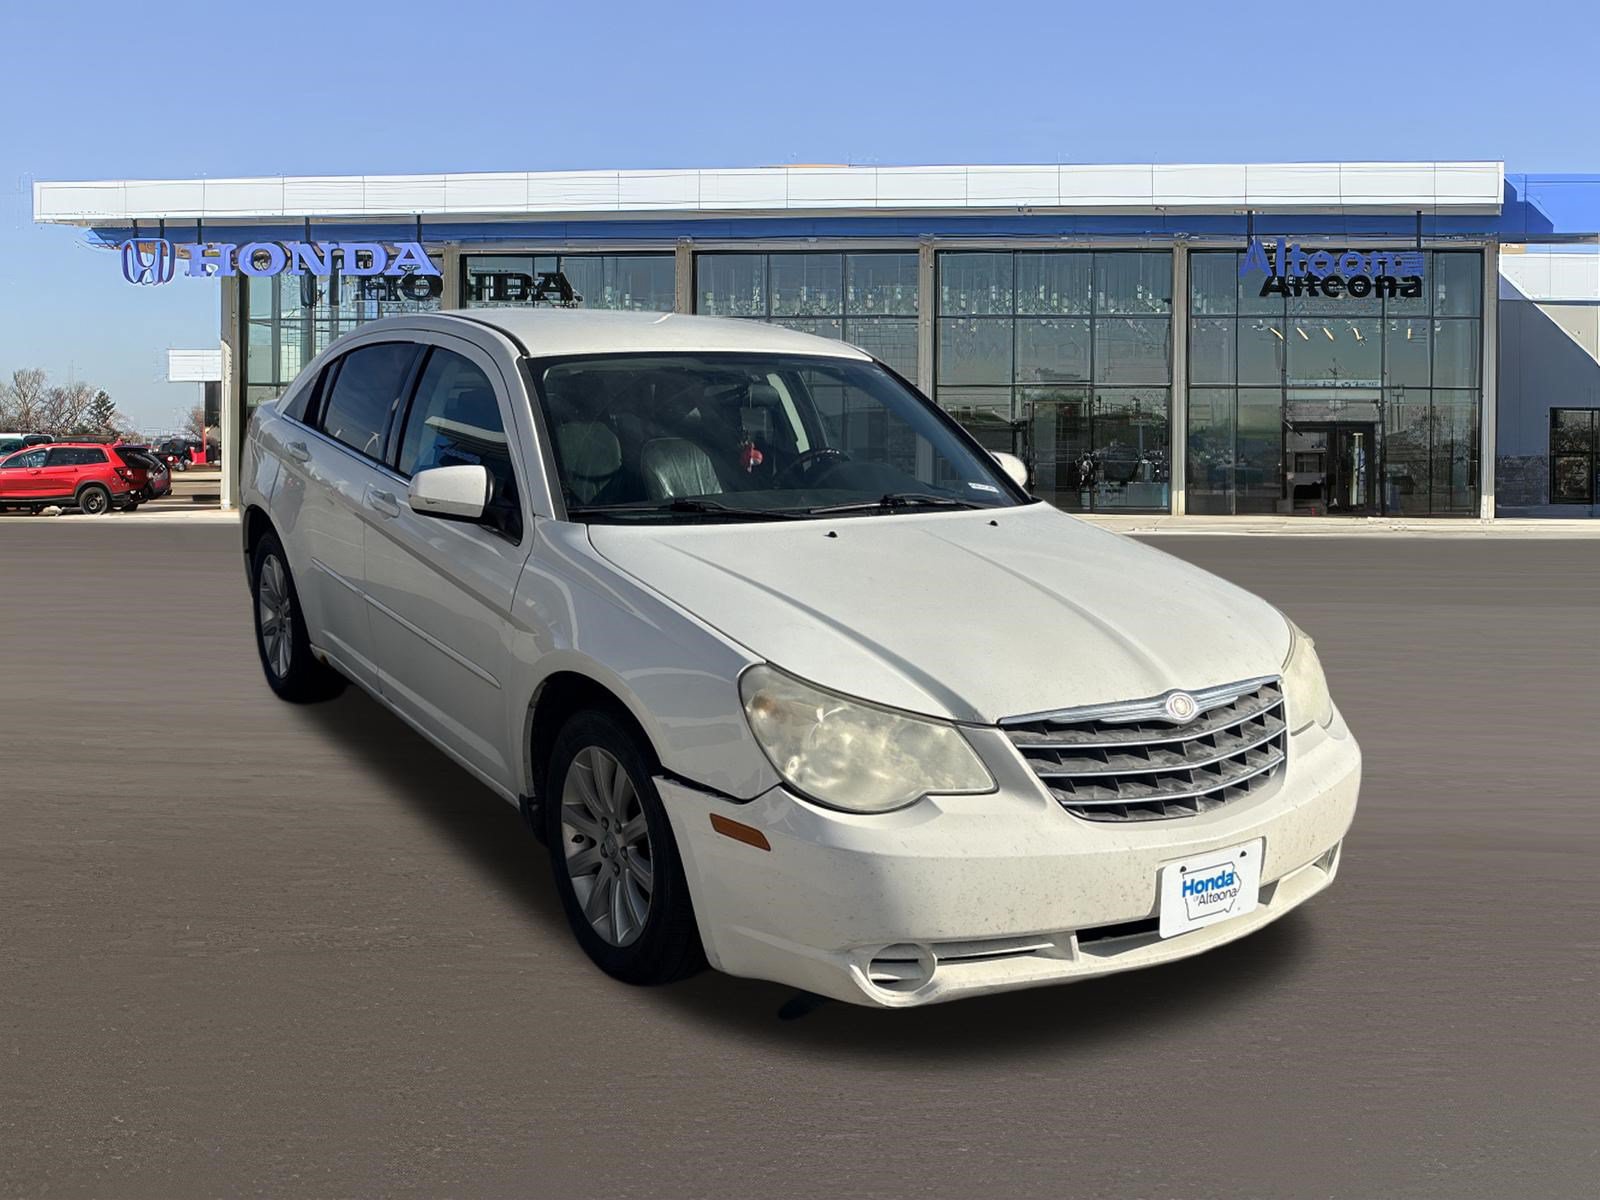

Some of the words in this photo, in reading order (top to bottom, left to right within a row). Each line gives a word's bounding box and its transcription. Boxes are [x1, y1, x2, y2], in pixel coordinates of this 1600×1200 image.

[184, 240, 441, 277] HONDA
[1181, 870, 1235, 898] Honda
[1198, 887, 1238, 906] Altoona
